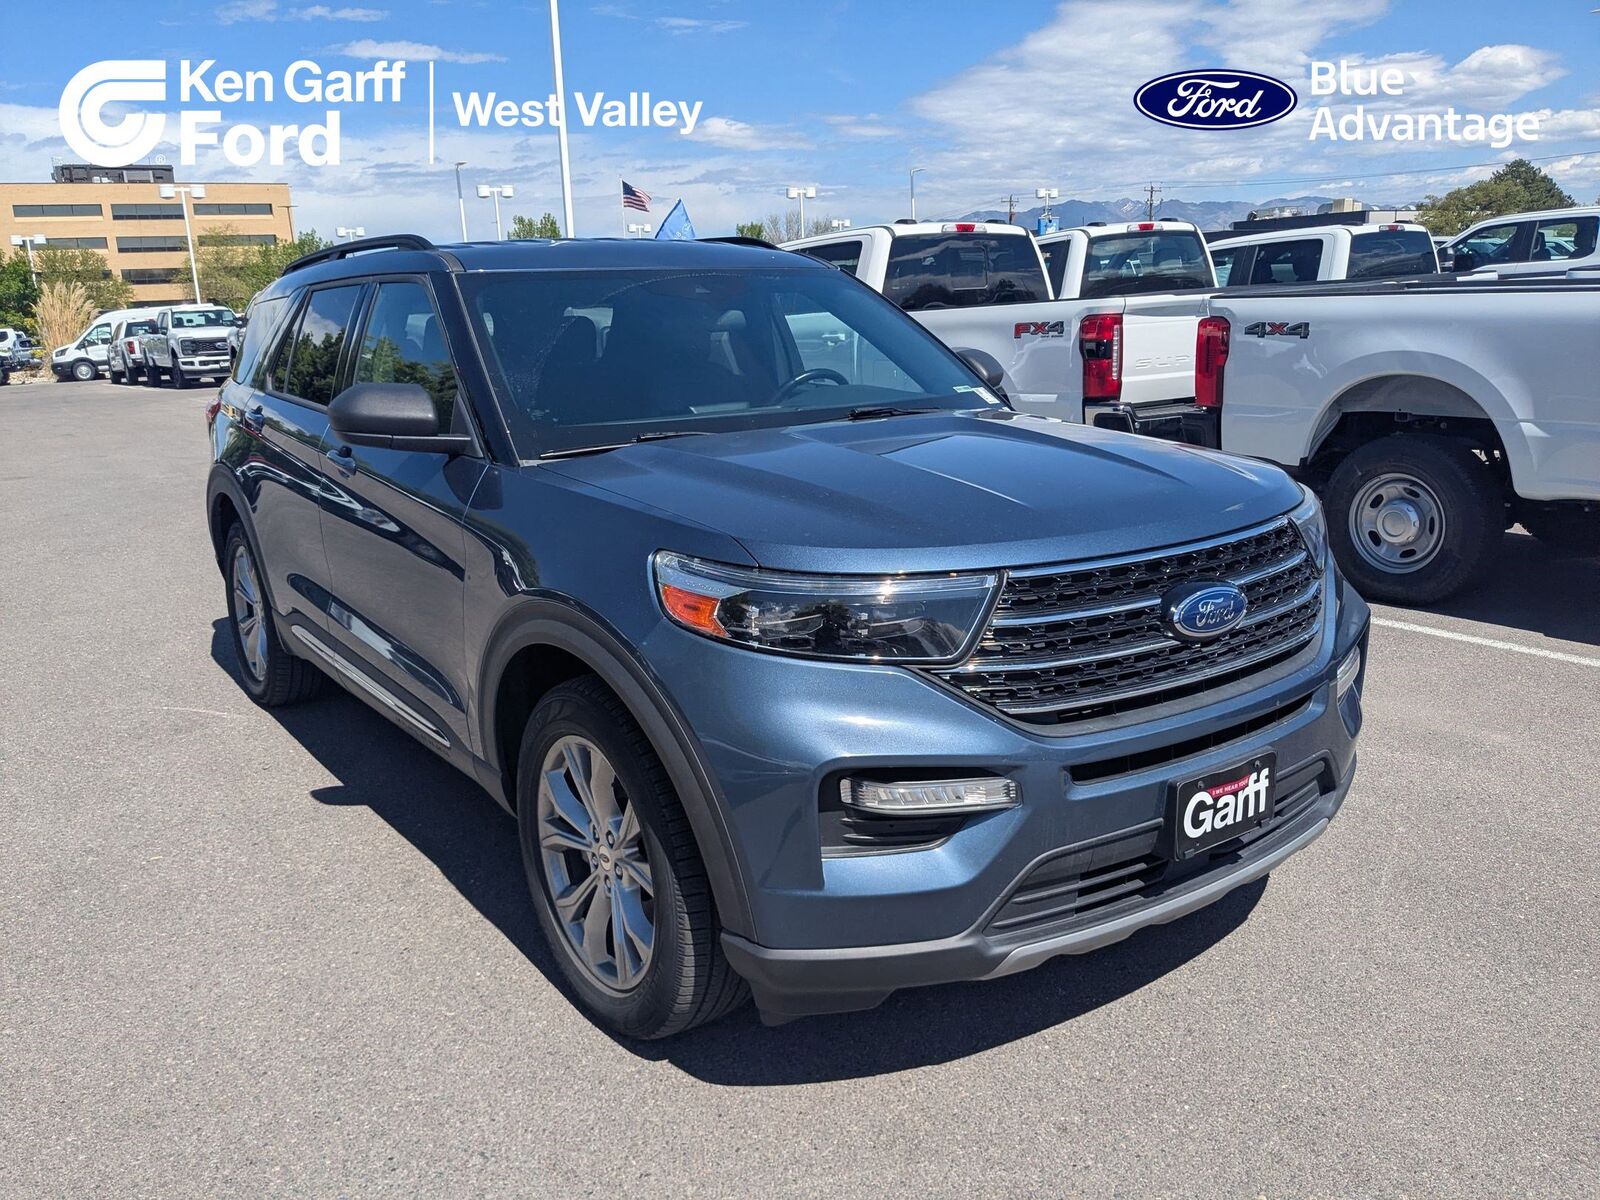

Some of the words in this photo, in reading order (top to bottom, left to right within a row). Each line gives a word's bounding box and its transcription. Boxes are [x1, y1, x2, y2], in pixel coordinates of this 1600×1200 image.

[1014, 320, 1065, 339] FX4
[1196, 597, 1235, 627] Ford
[1183, 767, 1270, 839] Garff
